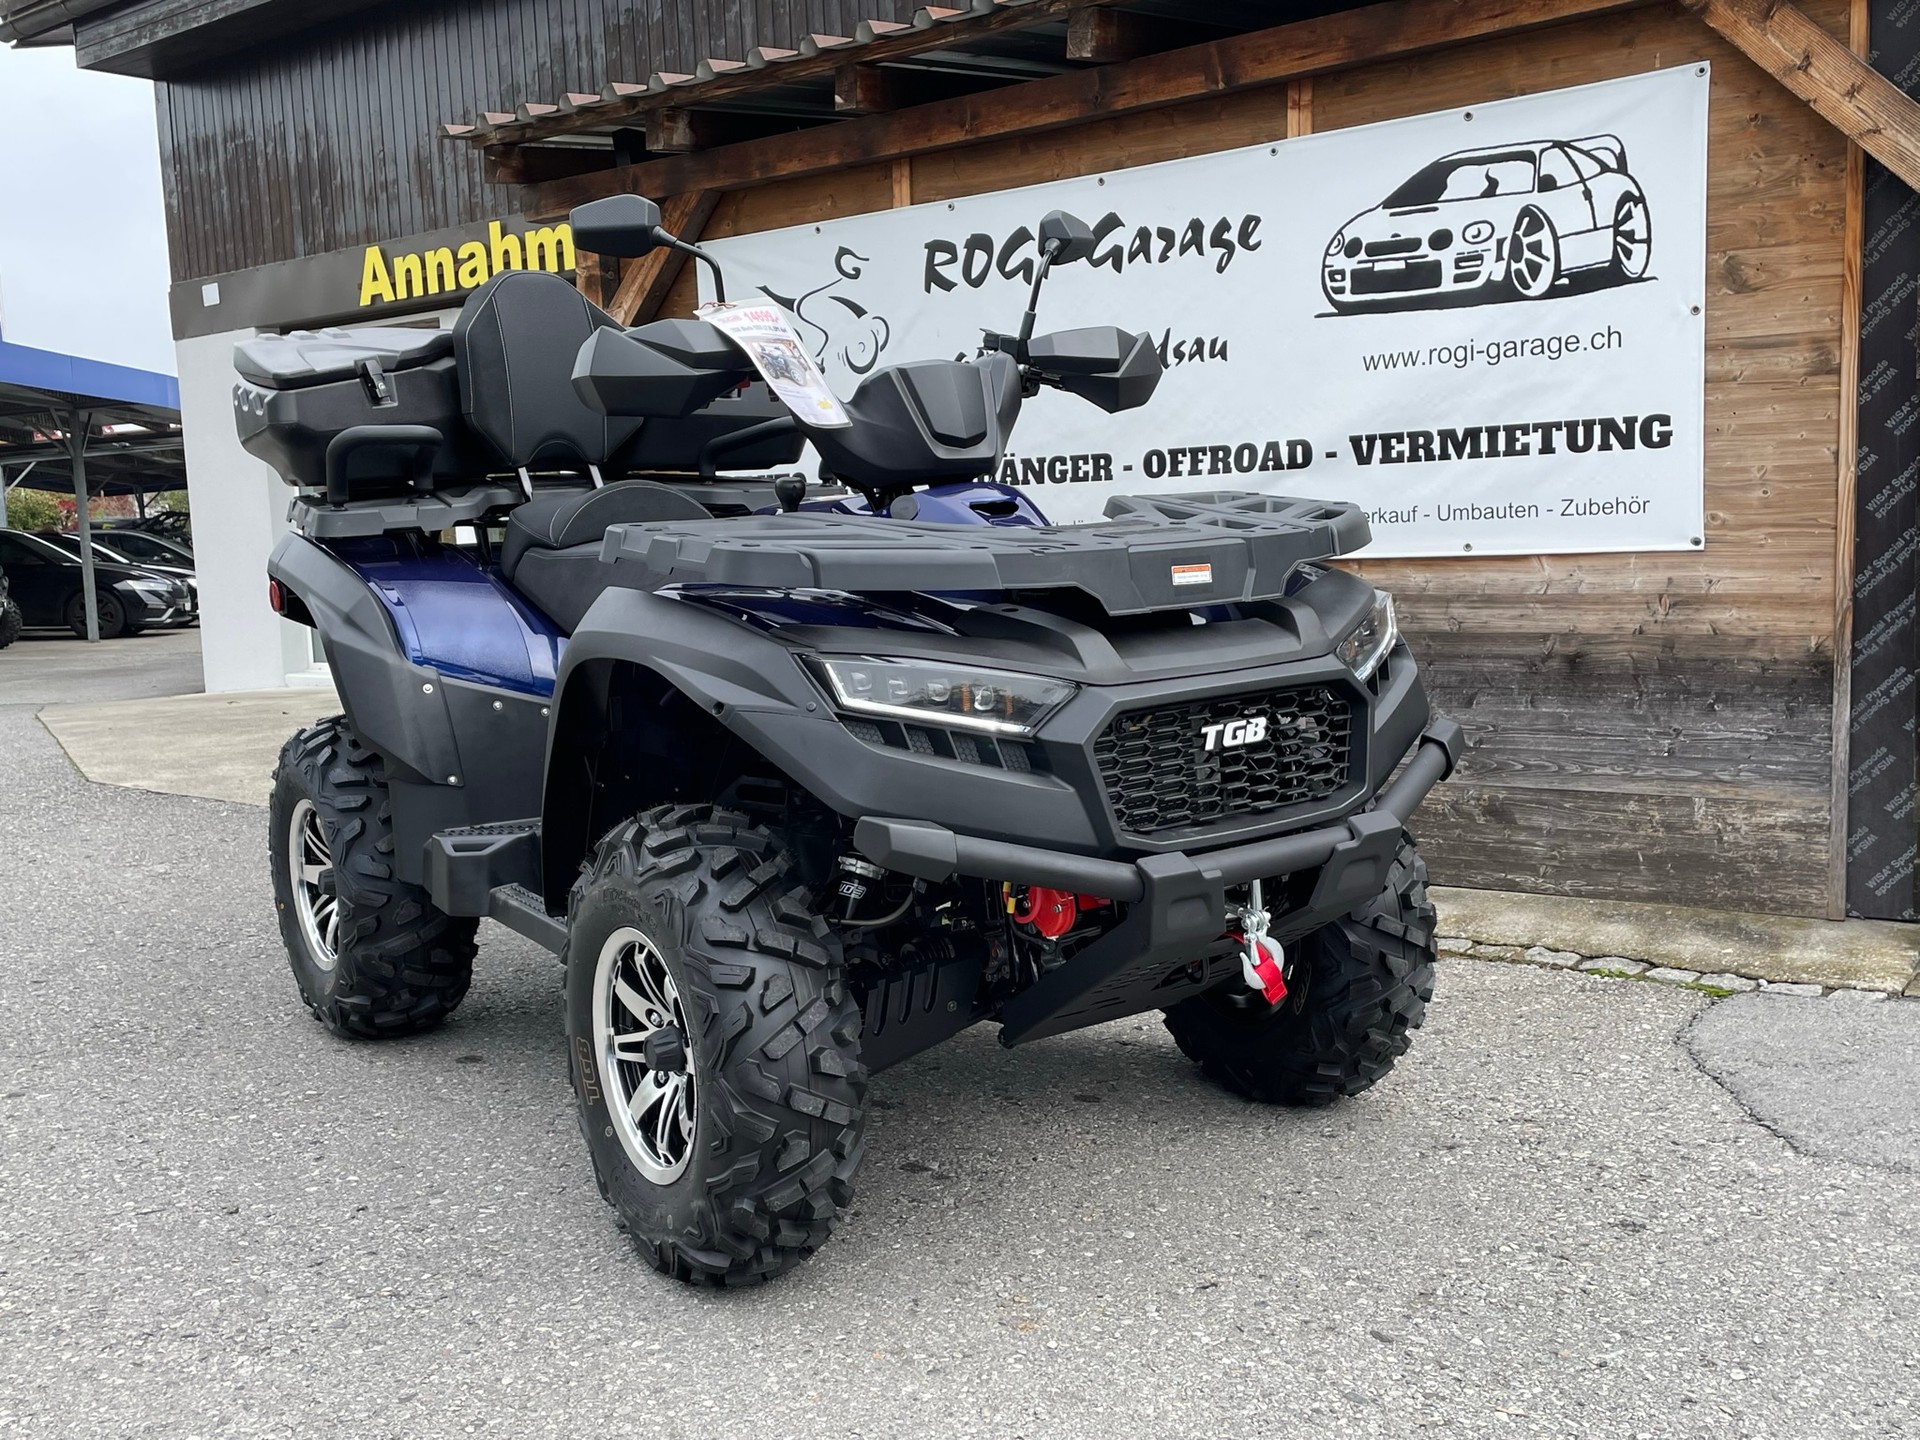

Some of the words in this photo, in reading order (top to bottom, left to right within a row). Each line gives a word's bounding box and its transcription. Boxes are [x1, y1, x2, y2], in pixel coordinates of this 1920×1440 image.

[924, 226, 1050, 294] ROG
[1086, 211, 1262, 274] Garage
[1154, 327, 1228, 370] dsau
[1362, 325, 1623, 372] www.rogi-garage.ch
[978, 452, 1113, 486] ÄNGER
[1143, 438, 1314, 479] OFFROAD
[1348, 413, 1674, 466] VERMIETUNG
[1364, 505, 1419, 525] erkauf
[1437, 502, 1539, 522] Umbauten
[1560, 496, 1651, 517] Zubehör
[1201, 716, 1267, 751] TGB
